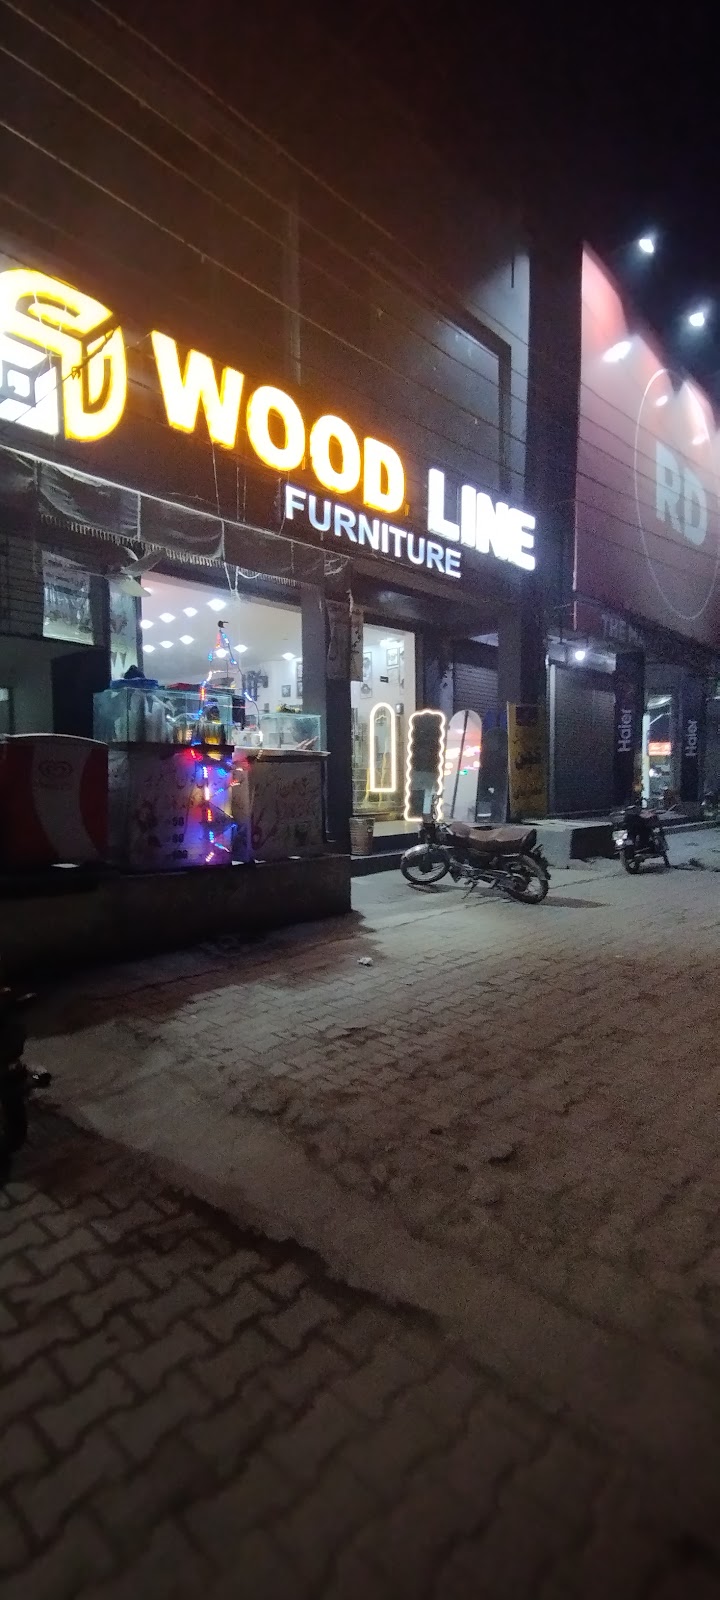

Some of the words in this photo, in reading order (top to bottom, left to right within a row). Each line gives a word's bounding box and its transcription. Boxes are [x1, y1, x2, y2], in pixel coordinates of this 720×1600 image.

[151, 329, 406, 514] WOOD
[427, 467, 537, 571] LINE
[655, 440, 708, 546] RD
[284, 484, 463, 579] FURNITURE
[617, 708, 632, 752] Haier
[685, 719, 698, 757] Haier
